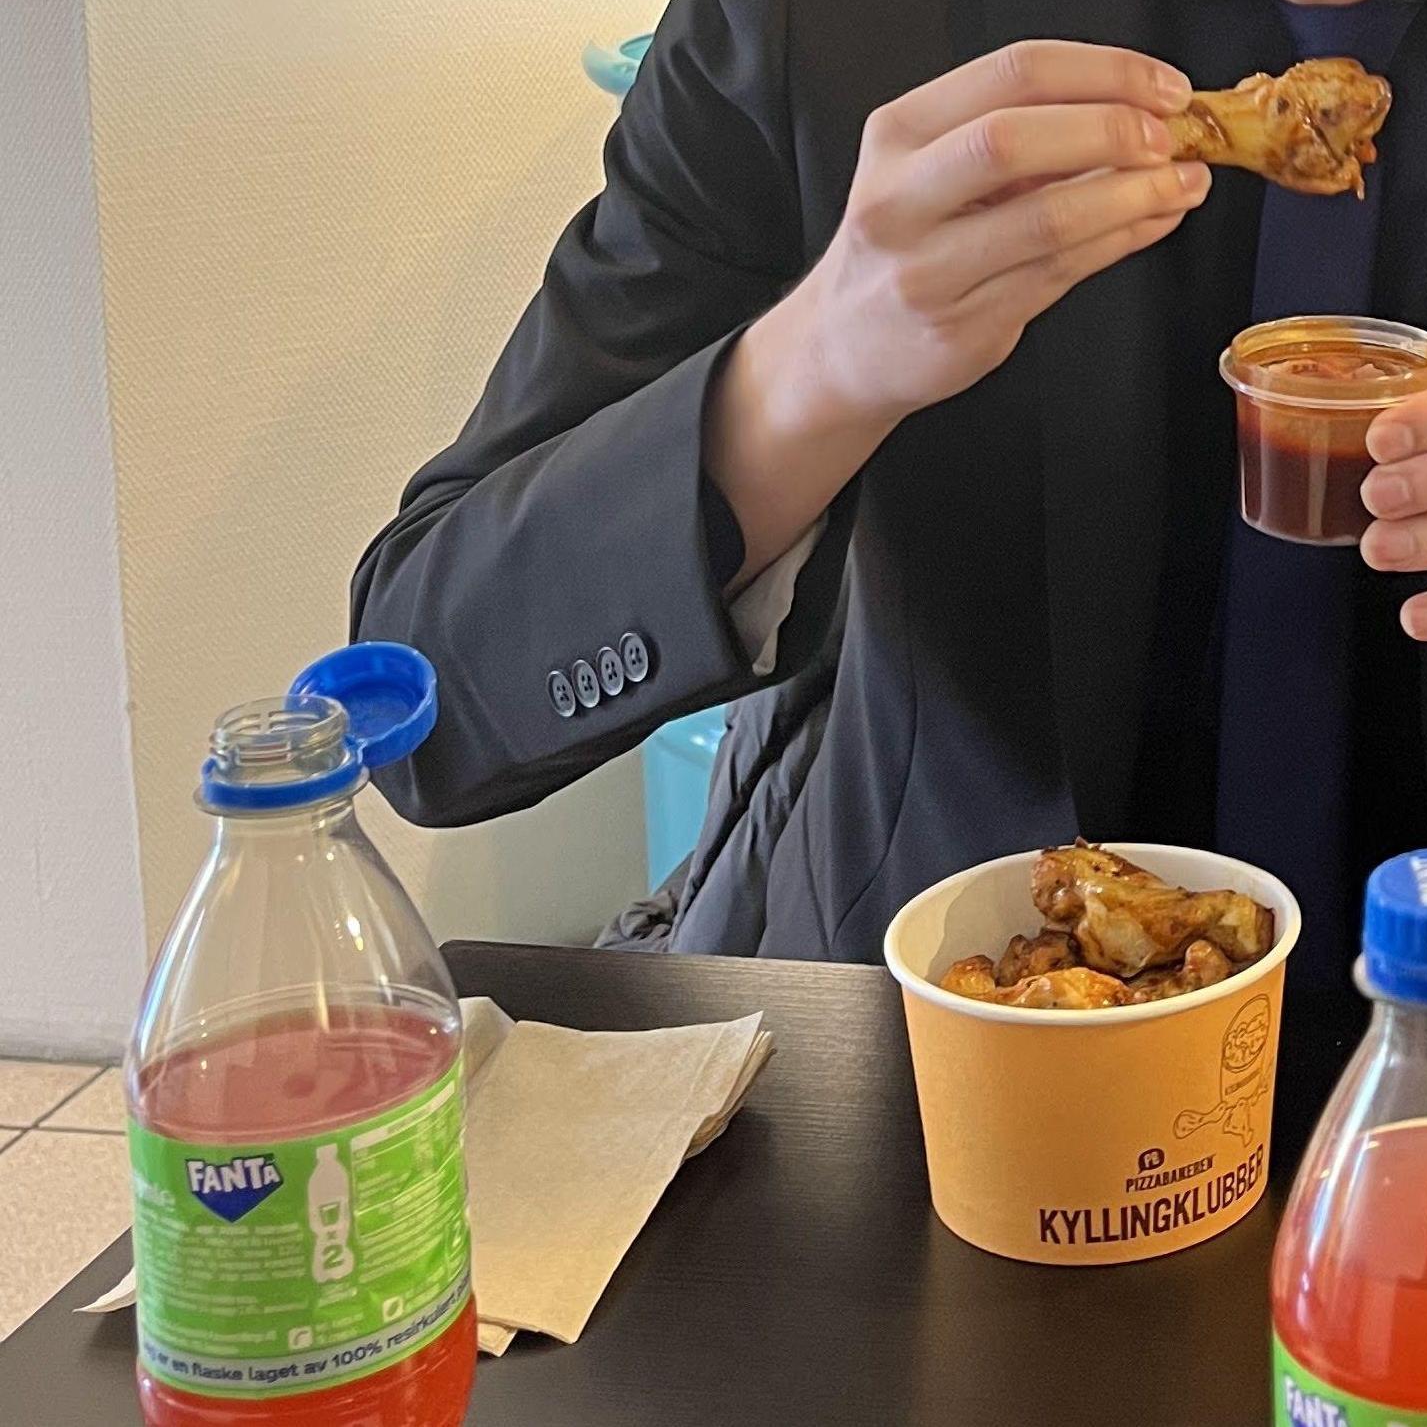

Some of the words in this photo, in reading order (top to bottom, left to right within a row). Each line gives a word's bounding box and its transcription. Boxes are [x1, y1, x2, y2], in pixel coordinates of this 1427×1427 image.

[186, 1157, 281, 1193] FANTA
[1040, 1144, 1264, 1245] KYLLINGKLUBBER
[322, 1245, 345, 1270] 2
[193, 1361, 243, 1381] flaske
[248, 1363, 299, 1384] laget
[304, 1360, 327, 1375] av
[331, 1341, 383, 1369] 100%
